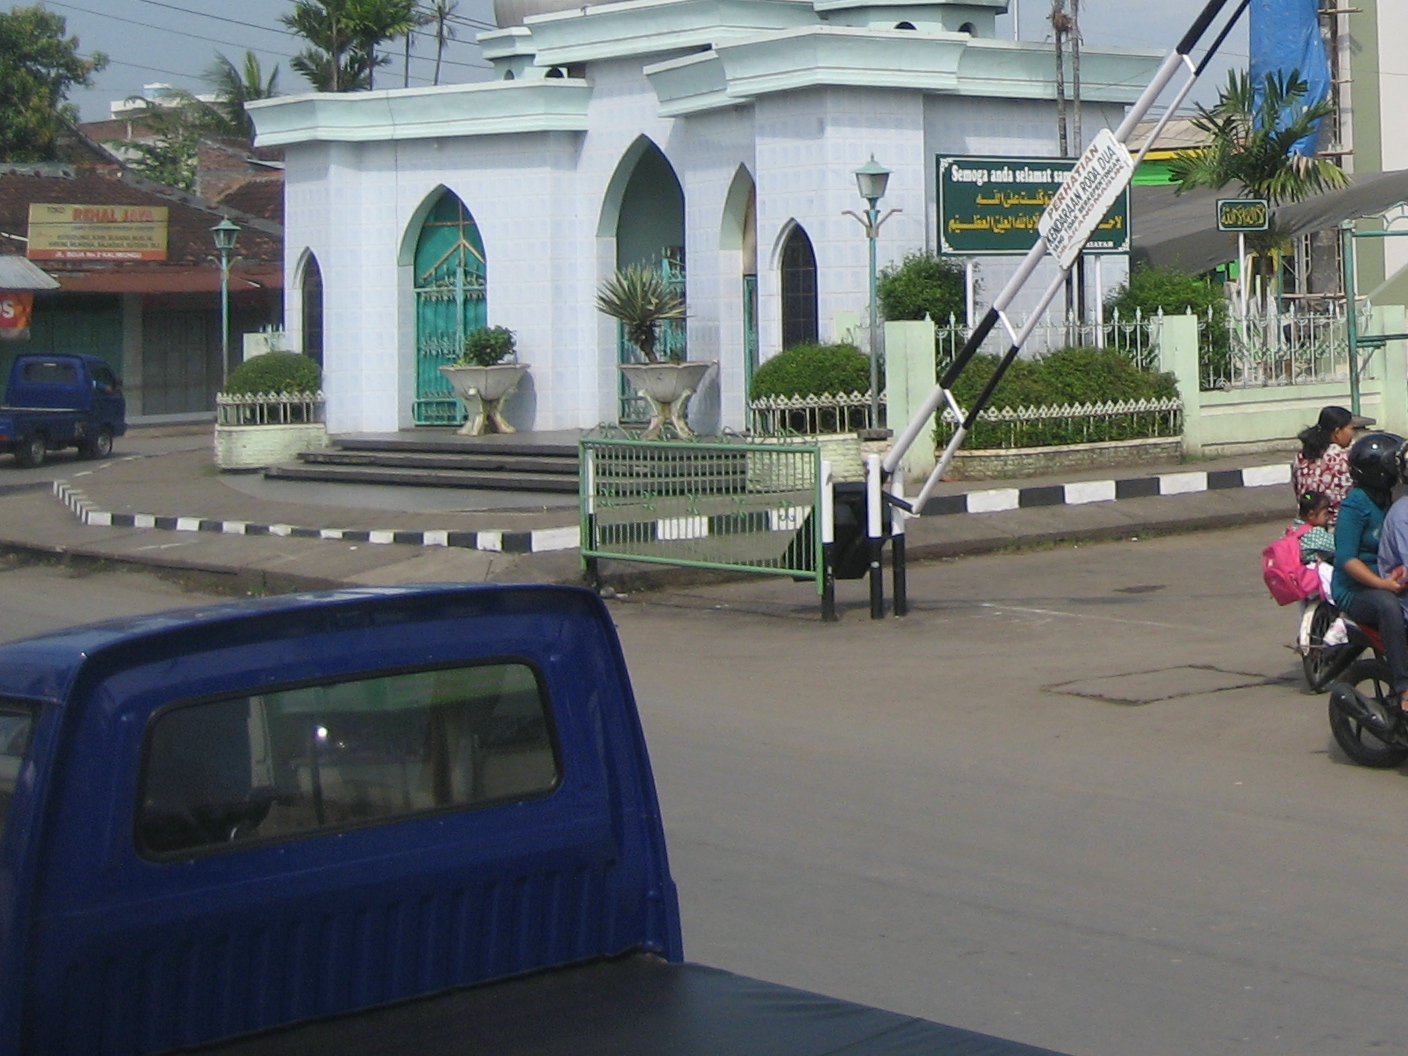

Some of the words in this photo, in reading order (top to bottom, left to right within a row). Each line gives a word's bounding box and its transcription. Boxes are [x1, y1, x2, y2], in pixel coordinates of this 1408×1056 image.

[951, 164, 988, 187] Semoga
[990, 166, 1013, 183] anda
[1015, 166, 1052, 183] selamat
[1046, 143, 1099, 221] PERHATIAN
[1046, 189, 1083, 248] KENDARAAN
[1097, 145, 1116, 171] DUA
